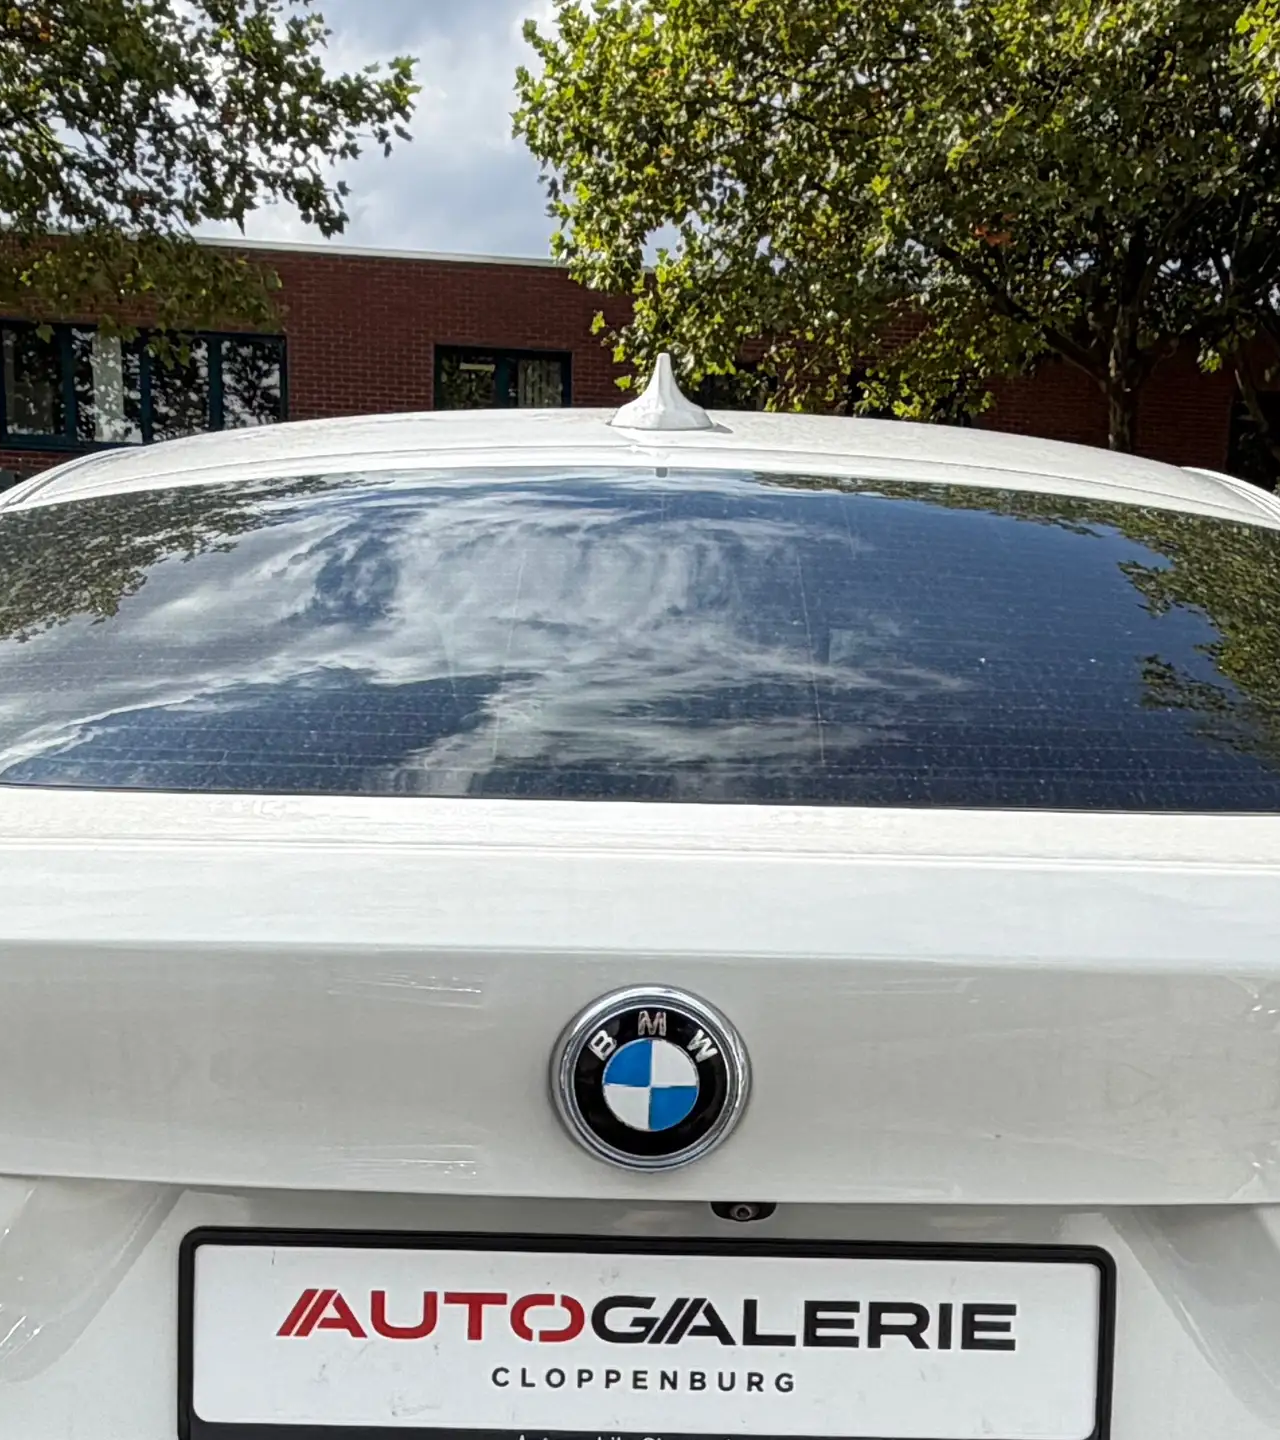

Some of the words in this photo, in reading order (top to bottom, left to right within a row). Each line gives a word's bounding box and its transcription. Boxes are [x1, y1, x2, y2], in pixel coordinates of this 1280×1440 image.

[588, 1011, 718, 1062] BMW
[276, 1288, 1017, 1351] AUTOGALERIE
[491, 1366, 795, 1393] CLOPPENBURG
